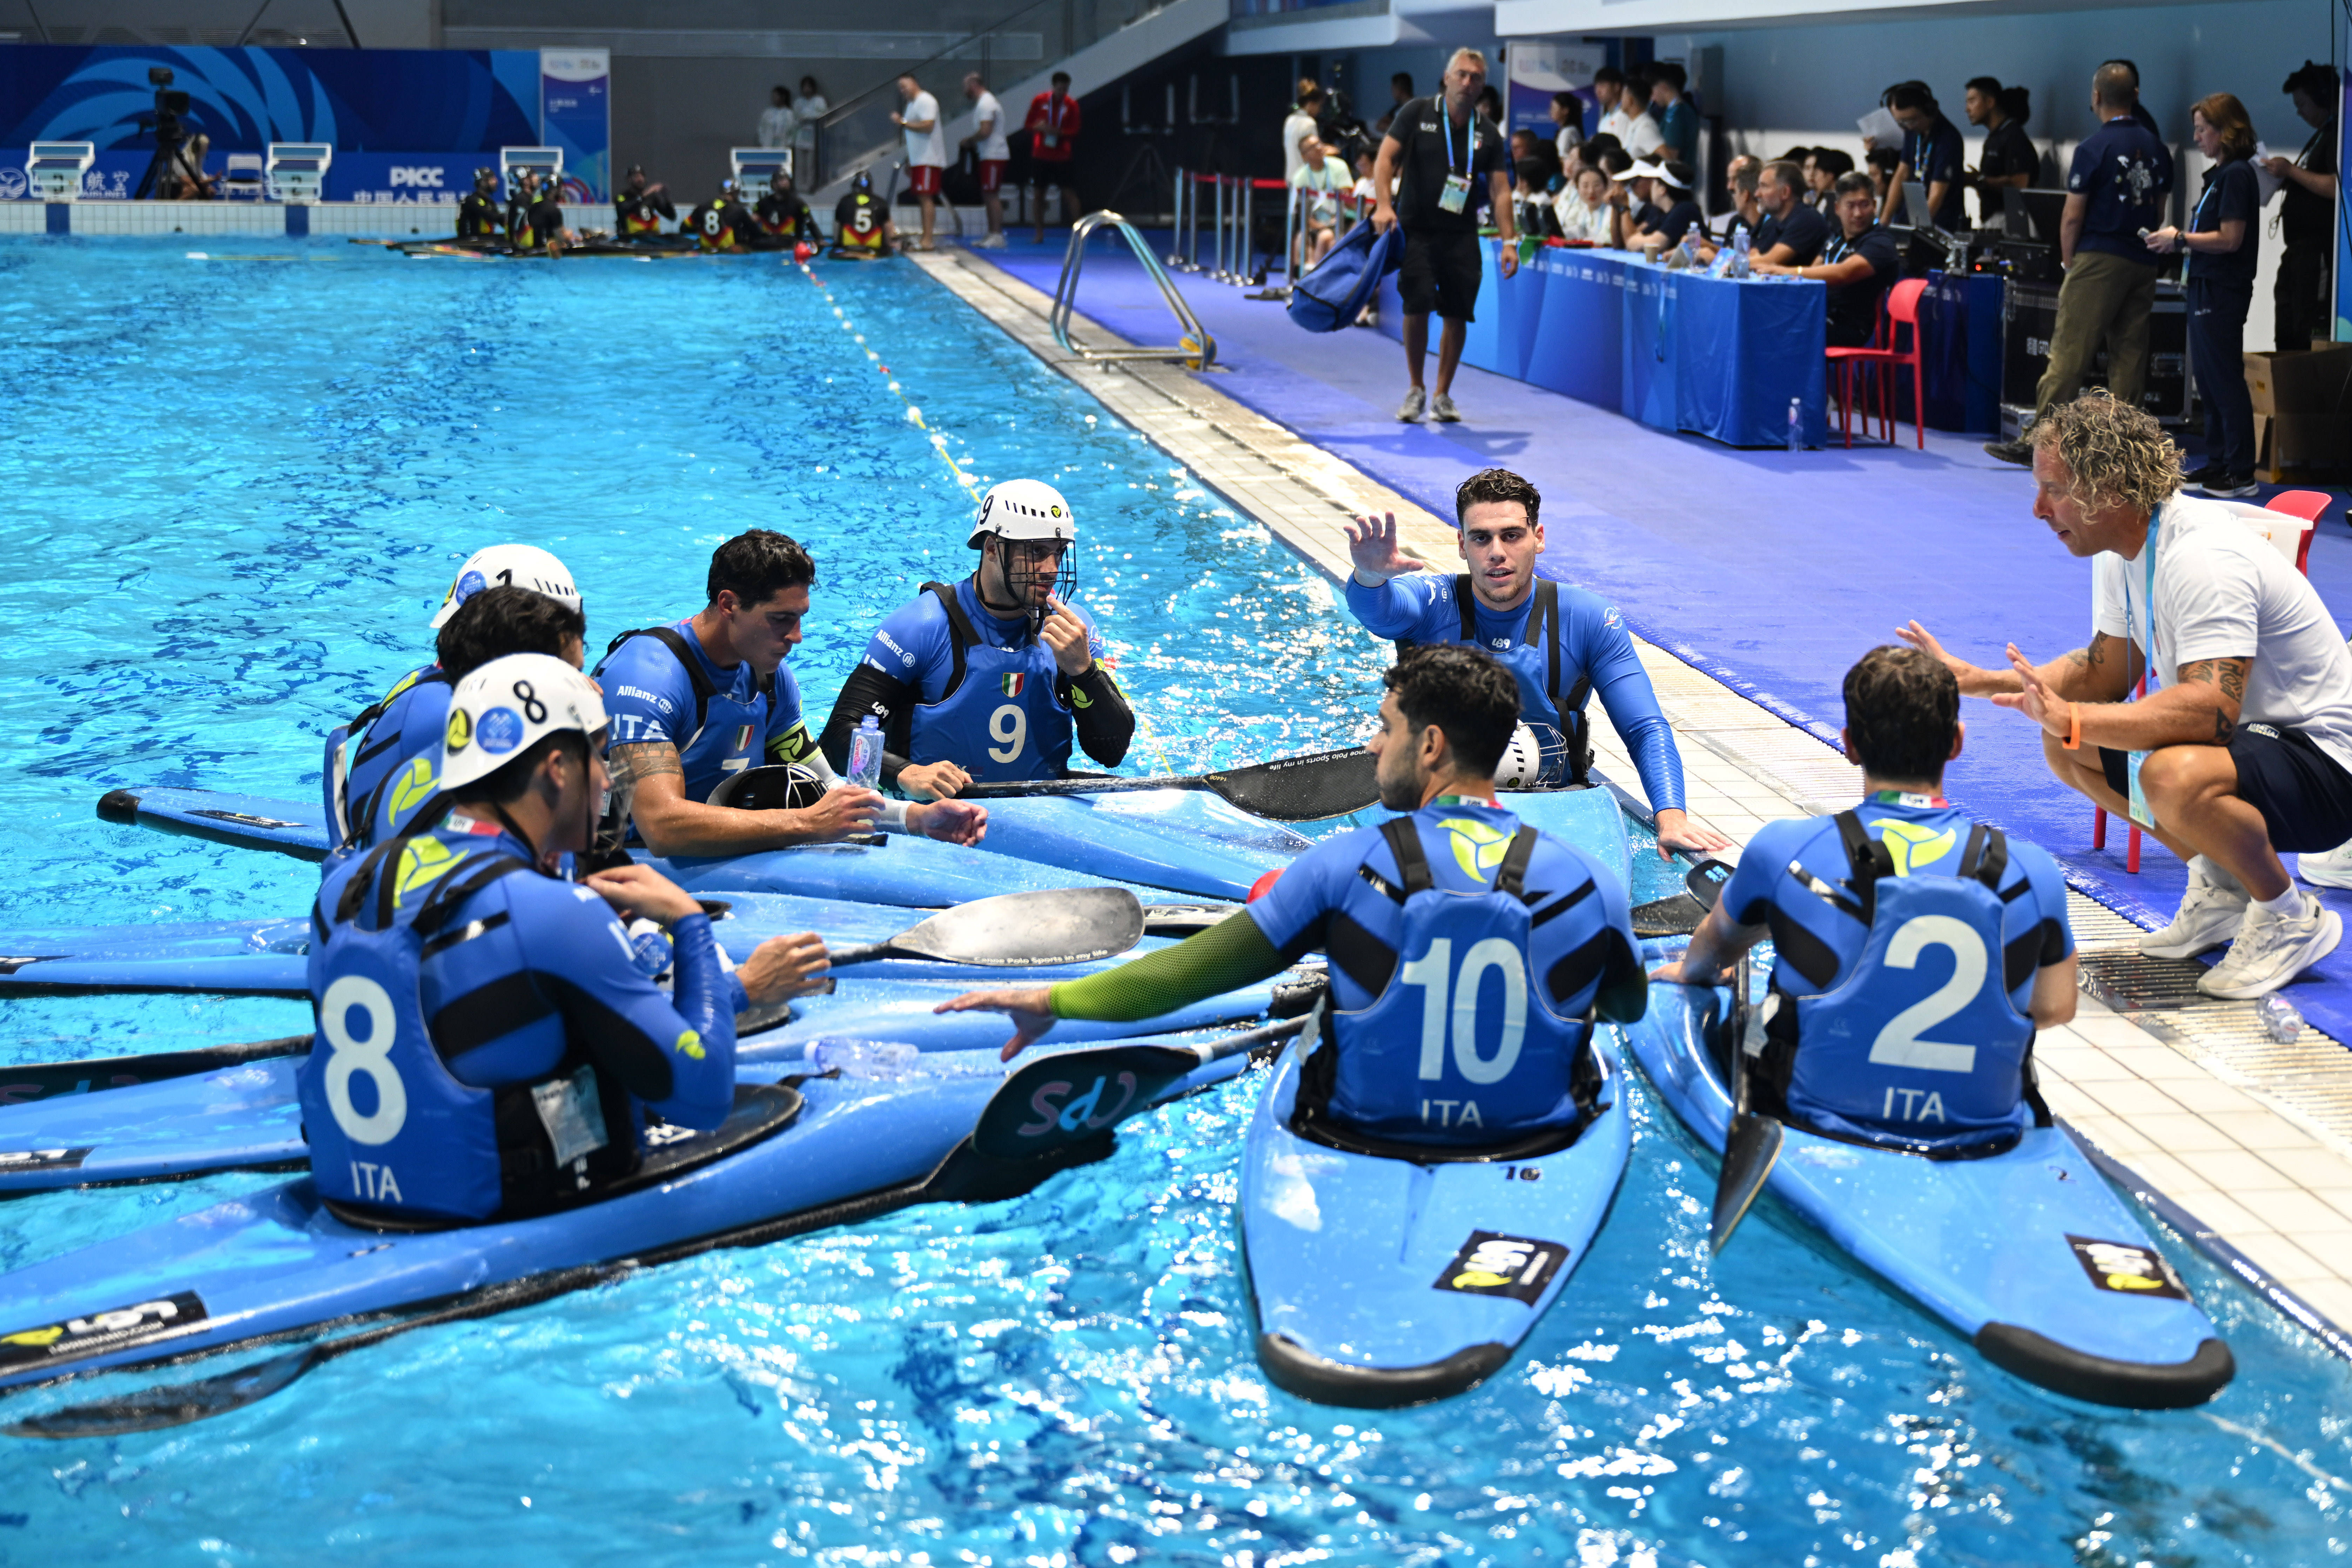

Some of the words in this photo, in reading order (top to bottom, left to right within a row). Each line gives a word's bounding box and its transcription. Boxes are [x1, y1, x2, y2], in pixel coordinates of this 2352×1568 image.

[1420, 122, 1437, 133] EA7
[390, 166, 444, 188] PICC
[704, 210, 720, 235] 8
[854, 208, 872, 233] 5
[980, 495, 994, 525] 9
[875, 629, 904, 657] Allianz
[863, 653, 898, 679] IT
[513, 680, 547, 725] 8
[617, 685, 658, 704] Allianz
[612, 713, 670, 740] ITA
[988, 704, 1027, 763] 9
[1283, 761, 1295, 769] my
[1306, 754, 1330, 764] Sports
[1031, 955, 1063, 964] Sports
[1076, 952, 1091, 961] my
[1868, 914, 1988, 1073] 2
[1402, 937, 1528, 1085] 10
[322, 975, 408, 1146] 8
[1422, 1099, 1484, 1128] ITA
[1883, 1087, 1946, 1123] ITA
[351, 1160, 403, 1204] ITA
